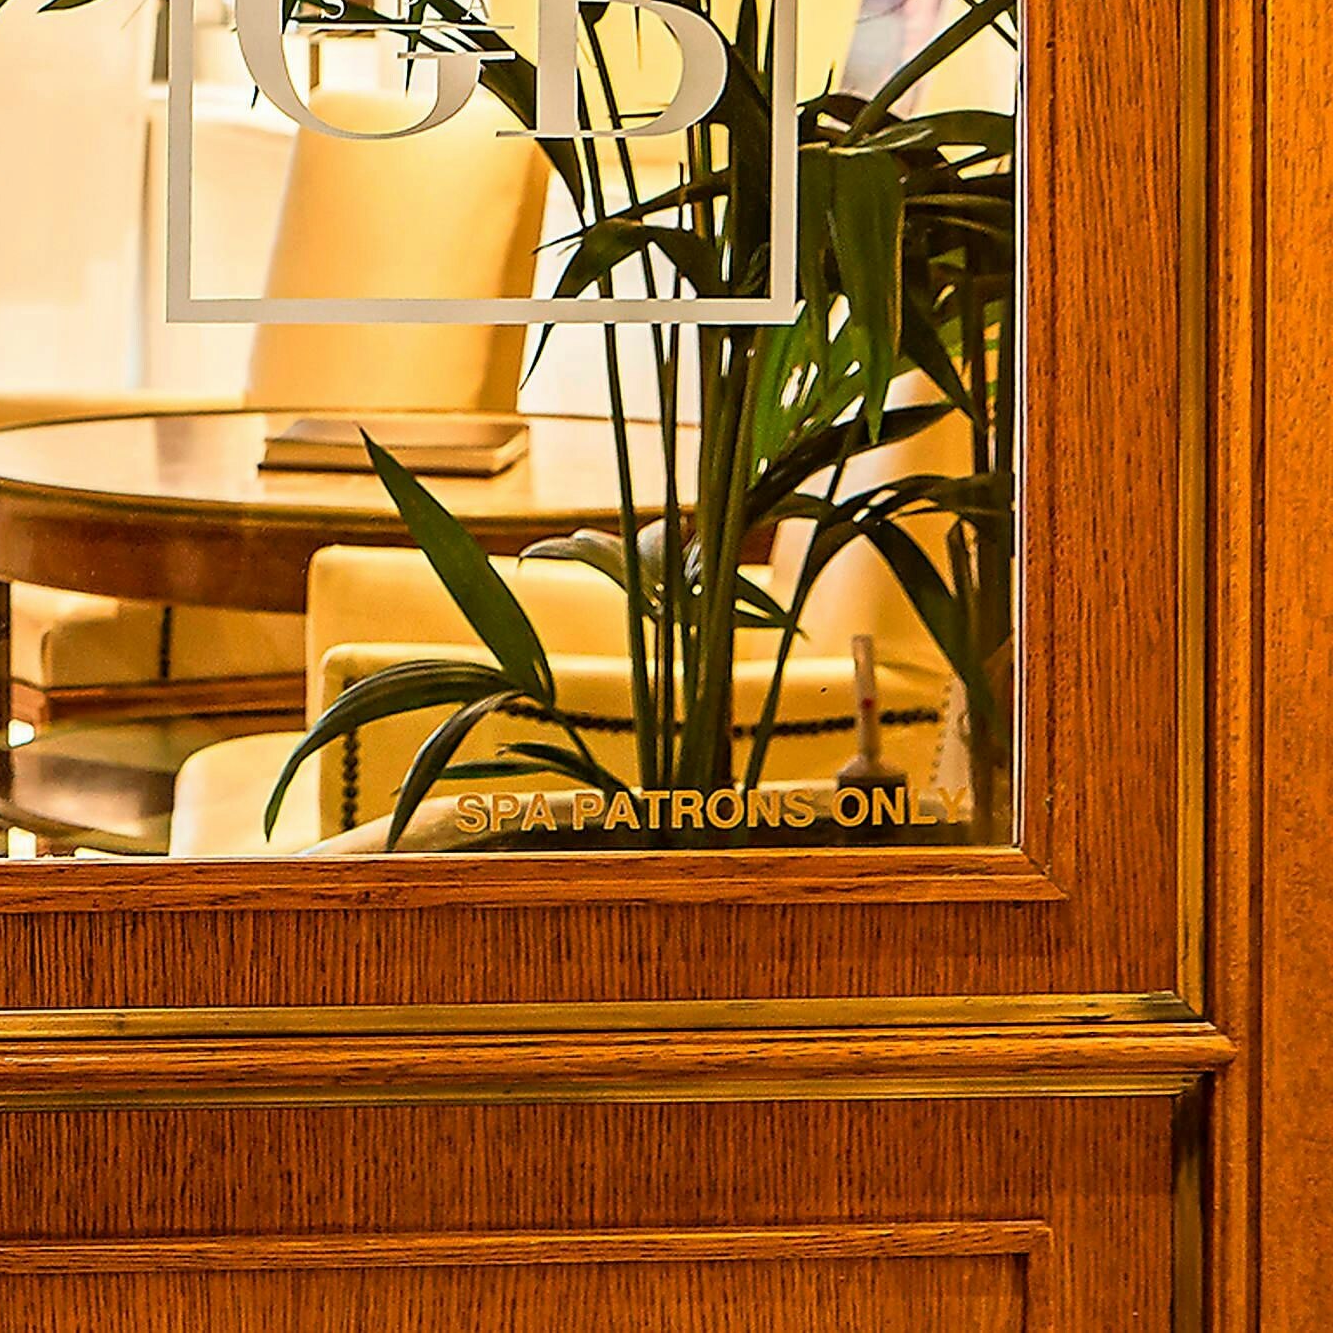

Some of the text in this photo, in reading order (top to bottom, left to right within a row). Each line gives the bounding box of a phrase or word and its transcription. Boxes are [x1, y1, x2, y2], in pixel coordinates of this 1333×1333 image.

[455, 785, 968, 833] SPA PATRONS ONLY
